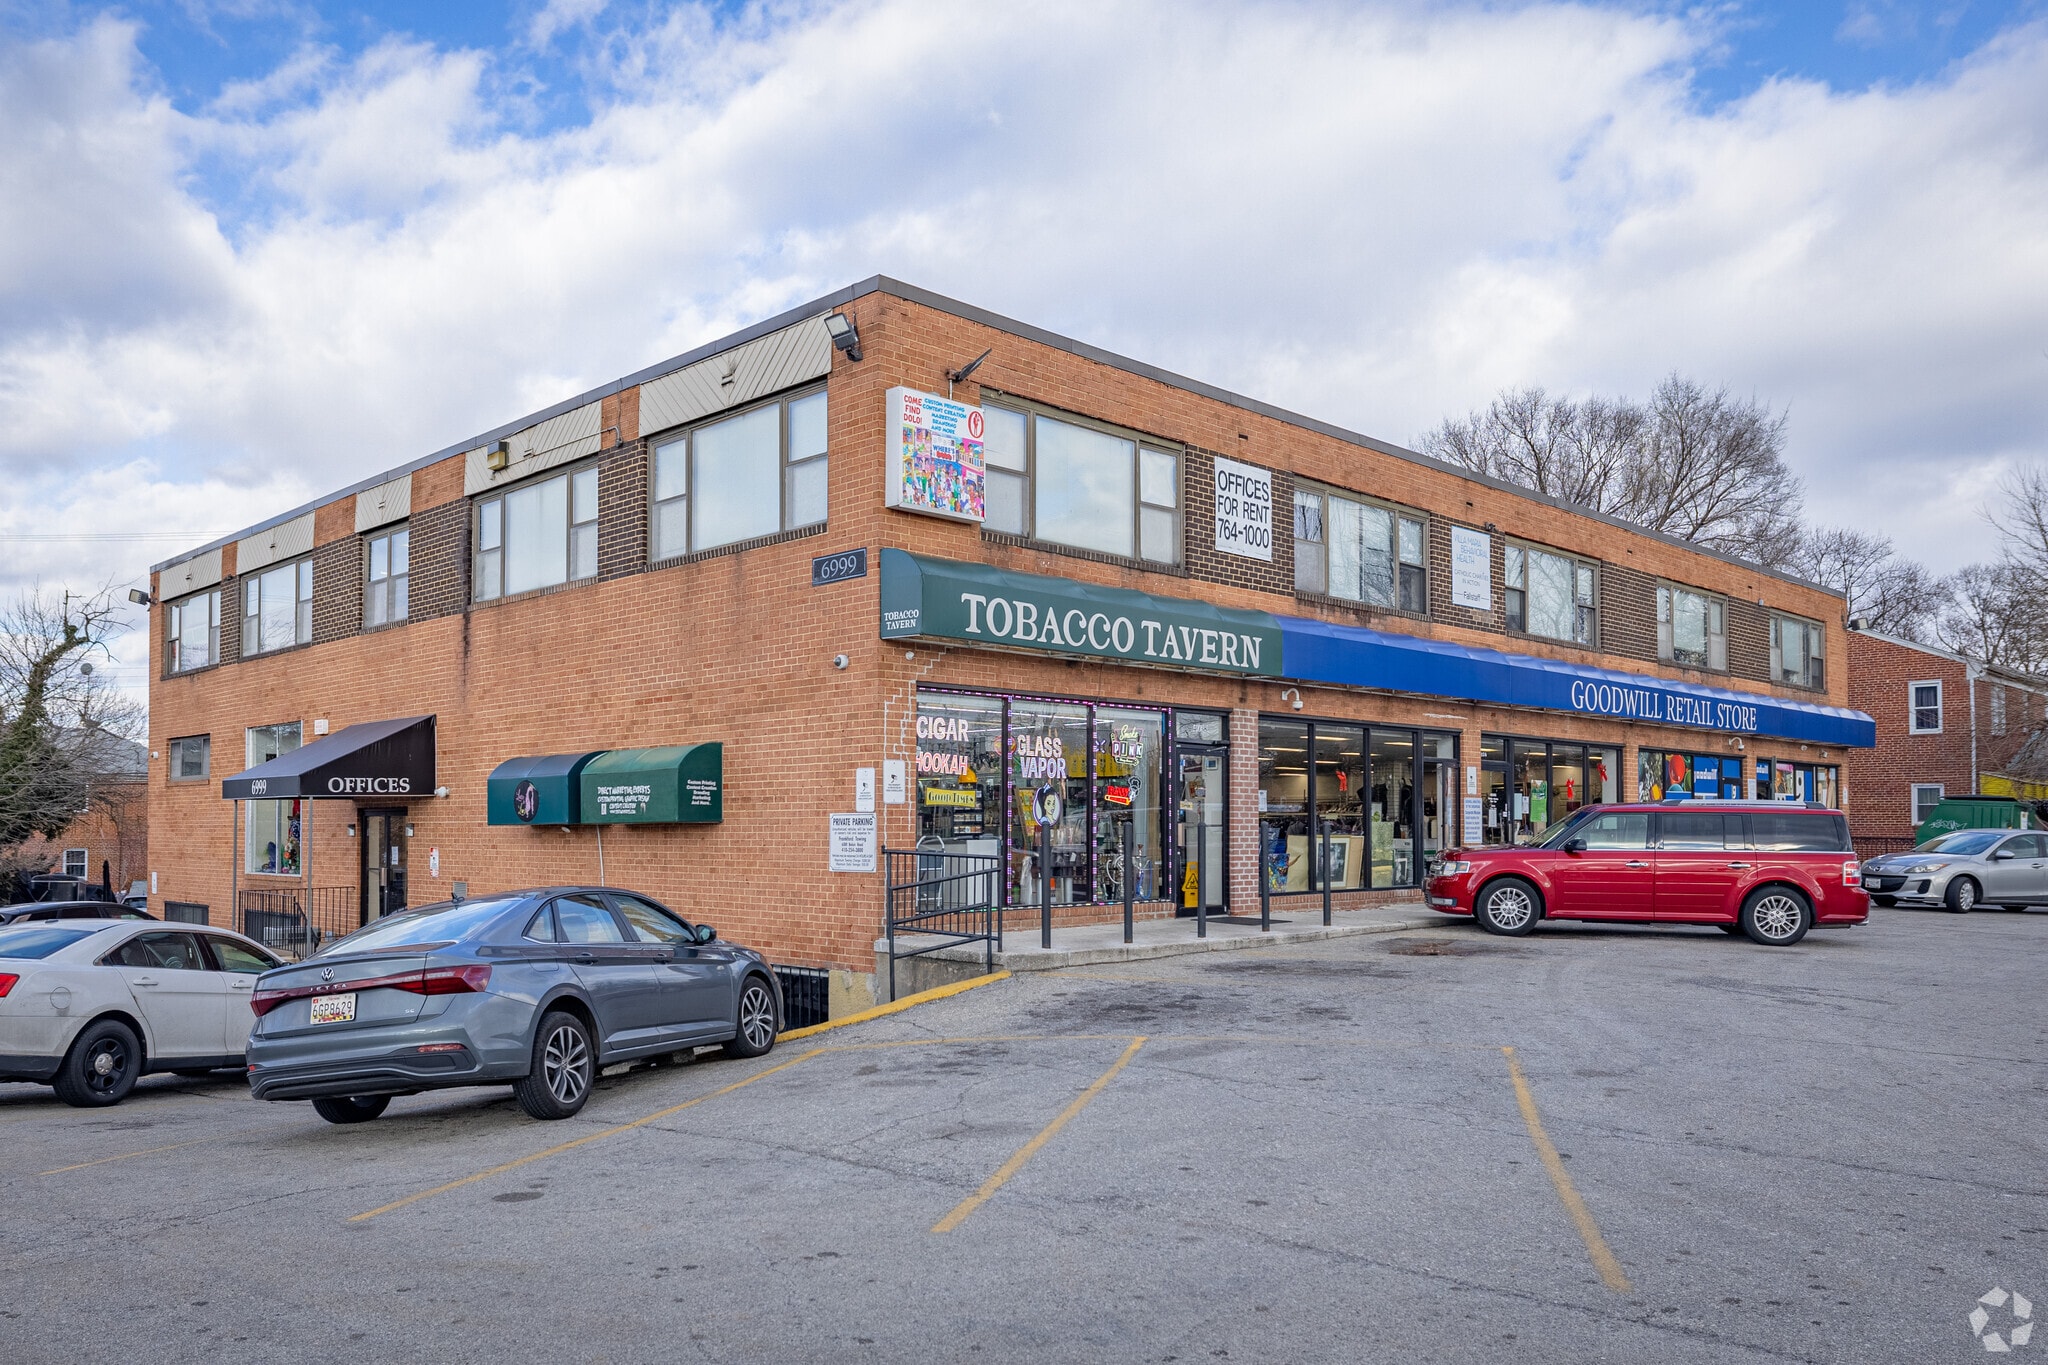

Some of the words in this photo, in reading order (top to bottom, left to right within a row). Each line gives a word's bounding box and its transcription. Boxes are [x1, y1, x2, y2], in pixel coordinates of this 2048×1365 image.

[904, 394, 922, 406] COME
[924, 398, 943, 407] CUSTOM
[944, 403, 965, 412] PRINTING
[905, 404, 920, 415] FIND
[922, 404, 943, 413] CONTENT
[944, 410, 966, 419] CREATION
[904, 413, 922, 425] DOLO!
[932, 413, 958, 423] MARKETING
[933, 419, 956, 428] BRANDING
[1218, 470, 1270, 502] OFFICES
[1218, 494, 1238, 517] FOR
[1242, 501, 1269, 524] RENT
[1218, 518, 1270, 548] 764-1000
[1456, 554, 1474, 564] HEALTH
[821, 555, 856, 579] 6999
[884, 609, 919, 621] TOBACCO
[886, 619, 916, 630] TAVERN
[961, 592, 1135, 653] TOBACCO
[1141, 620, 1262, 669] TAVERN
[1571, 680, 1662, 719] GOODWILL
[1666, 695, 1714, 726] RETAIL
[1717, 704, 1757, 730] STORE
[916, 716, 969, 742] CIGAR
[1017, 734, 1062, 758] GLASS
[1114, 743, 1141, 757] PINK
[916, 751, 968, 775] HOOKAH
[1020, 756, 1066, 779] VAPOR
[251, 780, 267, 795] 6999
[328, 777, 410, 793] OFFICES
[1107, 786, 1130, 796] RAW
[308, 984, 347, 992] JETTA
